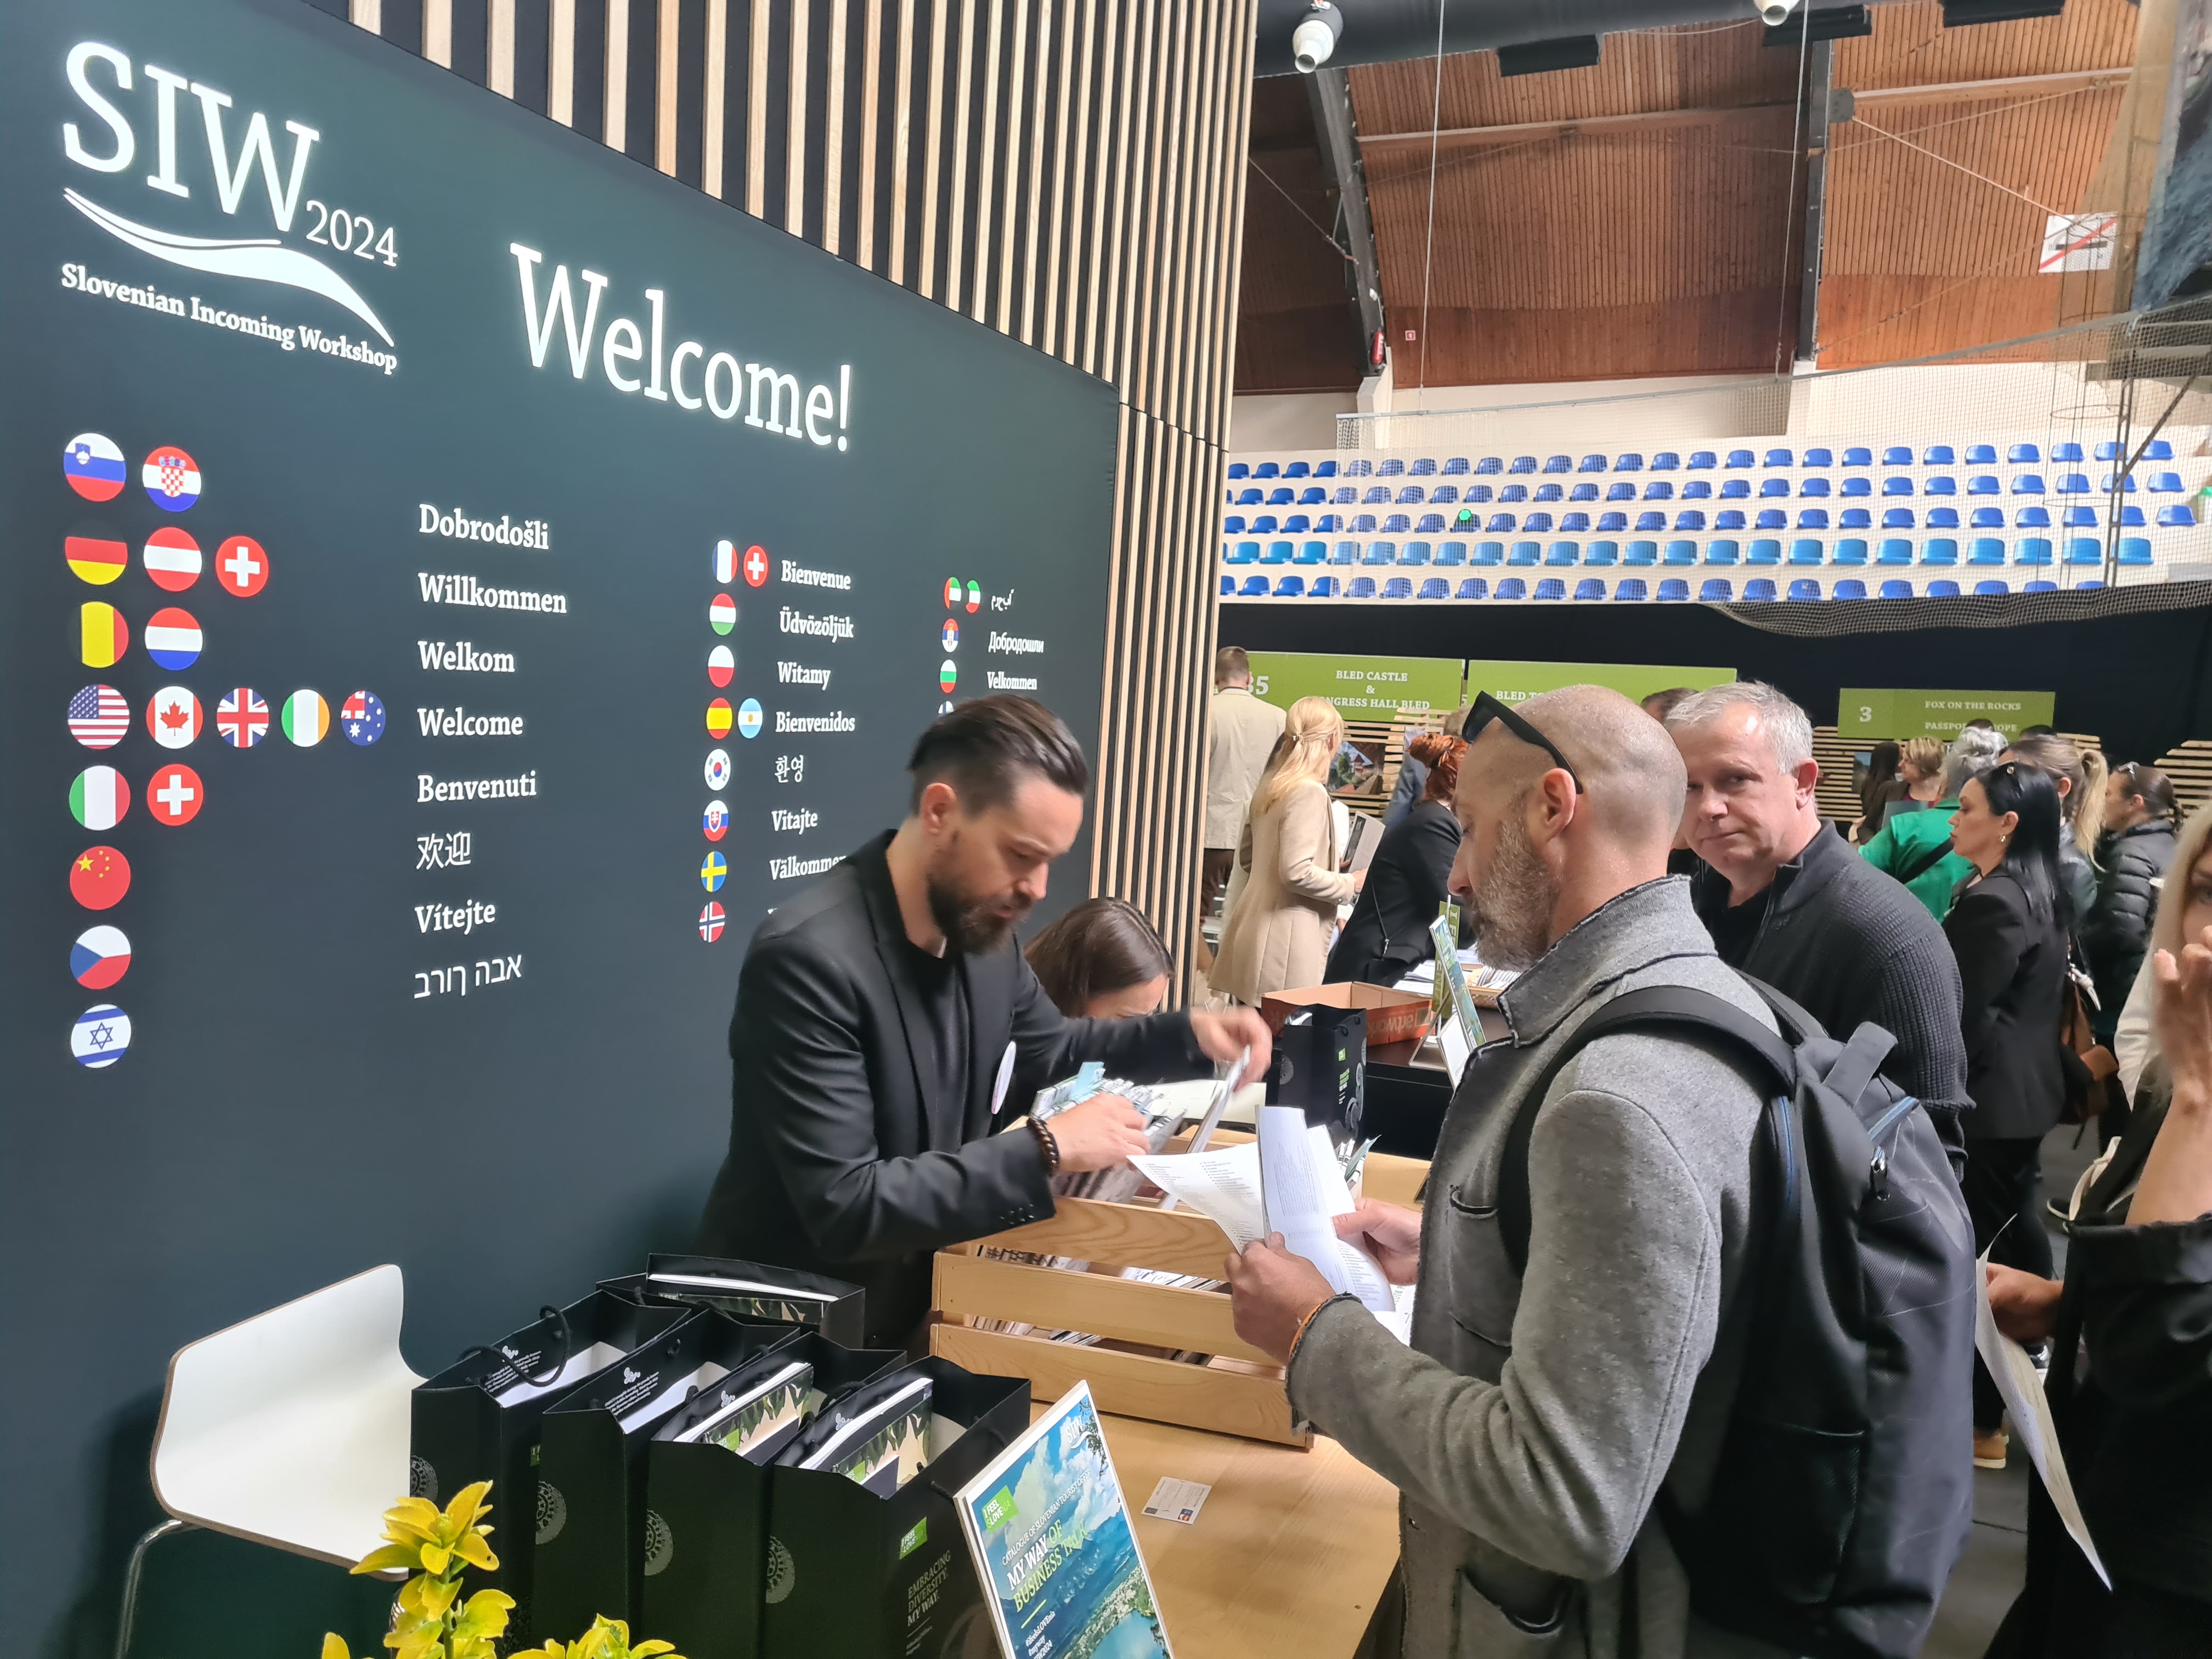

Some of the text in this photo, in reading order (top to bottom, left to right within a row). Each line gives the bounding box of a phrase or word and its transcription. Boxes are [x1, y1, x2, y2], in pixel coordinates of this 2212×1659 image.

[63, 42, 398, 267] SIW 2024
[61, 263, 397, 375] Slovenian Incoming Workshop
[510, 242, 850, 452] Welcome!
[419, 504, 549, 550] Dobrodošli
[781, 560, 851, 590] Bienvenue
[417, 572, 567, 613] Willkommen
[779, 606, 854, 643] Üdvözöljük
[417, 641, 515, 673] Welkom
[988, 631, 1045, 655] Добродошли
[777, 661, 831, 691] Witamy
[986, 671, 1037, 690] Velkommen
[1336, 670, 1408, 682] BLED CASTLE
[1365, 685, 1375, 694] &
[1321, 697, 1430, 710] NGRESS HALL BLED
[1496, 690, 1526, 701] BLED
[1965, 702, 1985, 710] THE
[1987, 702, 2021, 710] ROCKS
[417, 707, 523, 736] Welcome
[775, 710, 855, 732] Bienvenidos
[1859, 707, 1872, 723] 3
[1925, 722, 1966, 730] PASSPO
[774, 754, 804, 783] 환영
[417, 770, 537, 803] Benvenuti
[771, 808, 818, 835] Vitajte
[416, 831, 471, 870] 欢迎
[414, 899, 496, 935] Vítejte
[1066, 1415, 1084, 1444] SIW
[983, 1499, 1000, 1519] I FEEL
[1002, 1469, 1091, 1566] CATALOGUE OF SLOVENIAN TOURIST OFFER
[1007, 1519, 1063, 1590] MY WAY OF
[908, 1550, 951, 1600] EMBRACING
[1013, 1548, 1062, 1612] BUSINESS
[907, 1607, 920, 1627] MY
